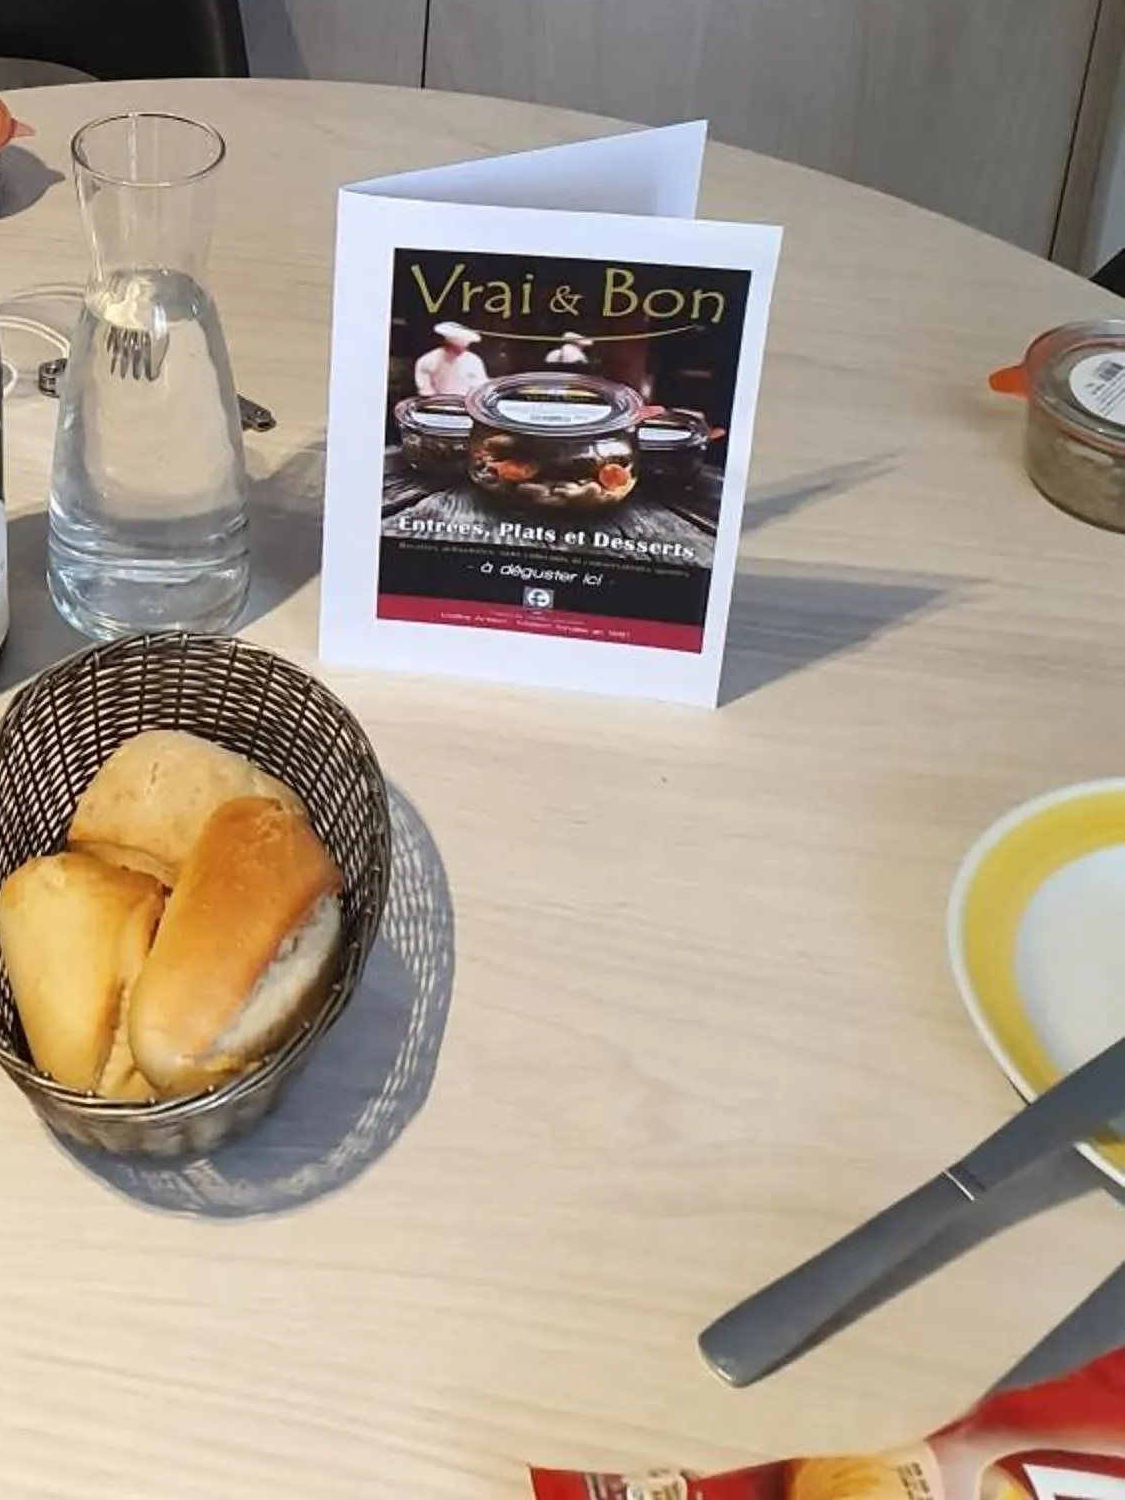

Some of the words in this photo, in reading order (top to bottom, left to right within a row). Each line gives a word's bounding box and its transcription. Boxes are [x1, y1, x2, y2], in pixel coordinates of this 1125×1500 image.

[411, 263, 535, 319] Vrai
[549, 285, 583, 316] &
[602, 267, 725, 324] Bon
[499, 522, 556, 541] Plats
[564, 531, 586, 546] et
[593, 531, 694, 559] Desserts
[499, 563, 578, 583] déguster
